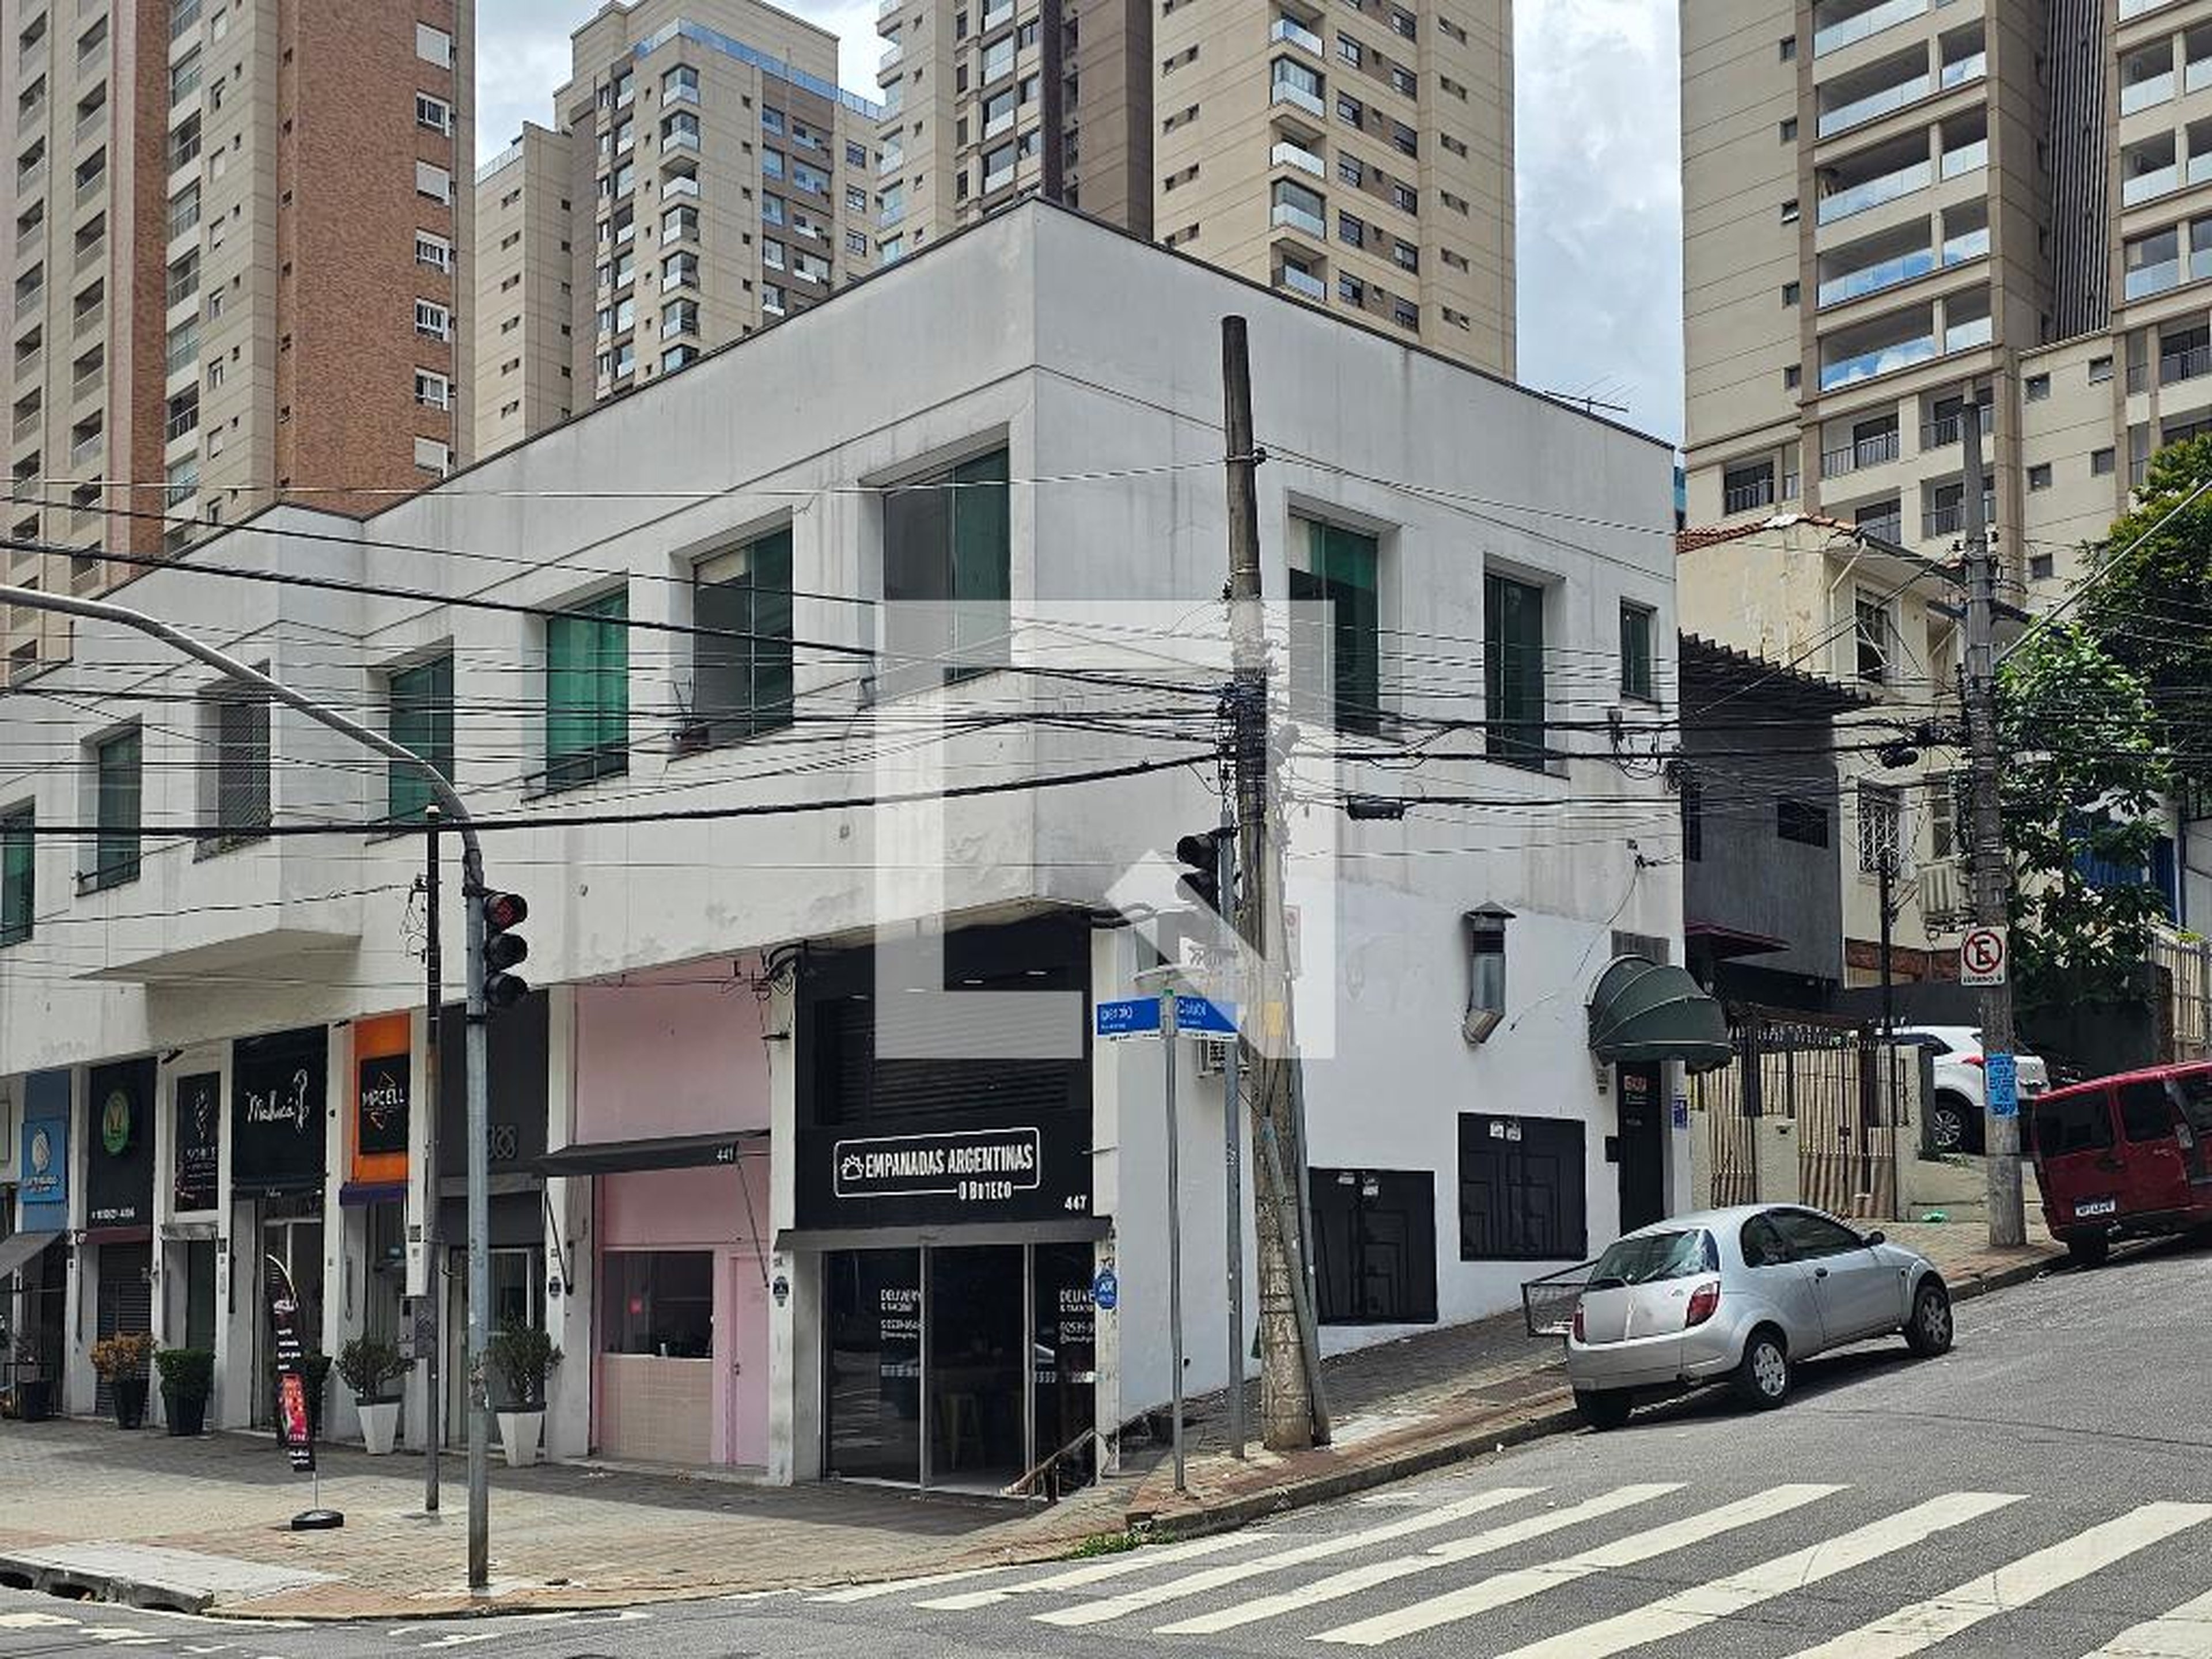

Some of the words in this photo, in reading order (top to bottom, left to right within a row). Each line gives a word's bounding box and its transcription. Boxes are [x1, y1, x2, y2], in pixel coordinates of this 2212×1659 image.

[716, 1147, 733, 1161] 441
[865, 1149, 945, 1179] EMPANADAS
[948, 1144, 1033, 1174] ARGENTINAS
[959, 1181, 966, 1200] O
[1065, 1195, 1088, 1210] 447
